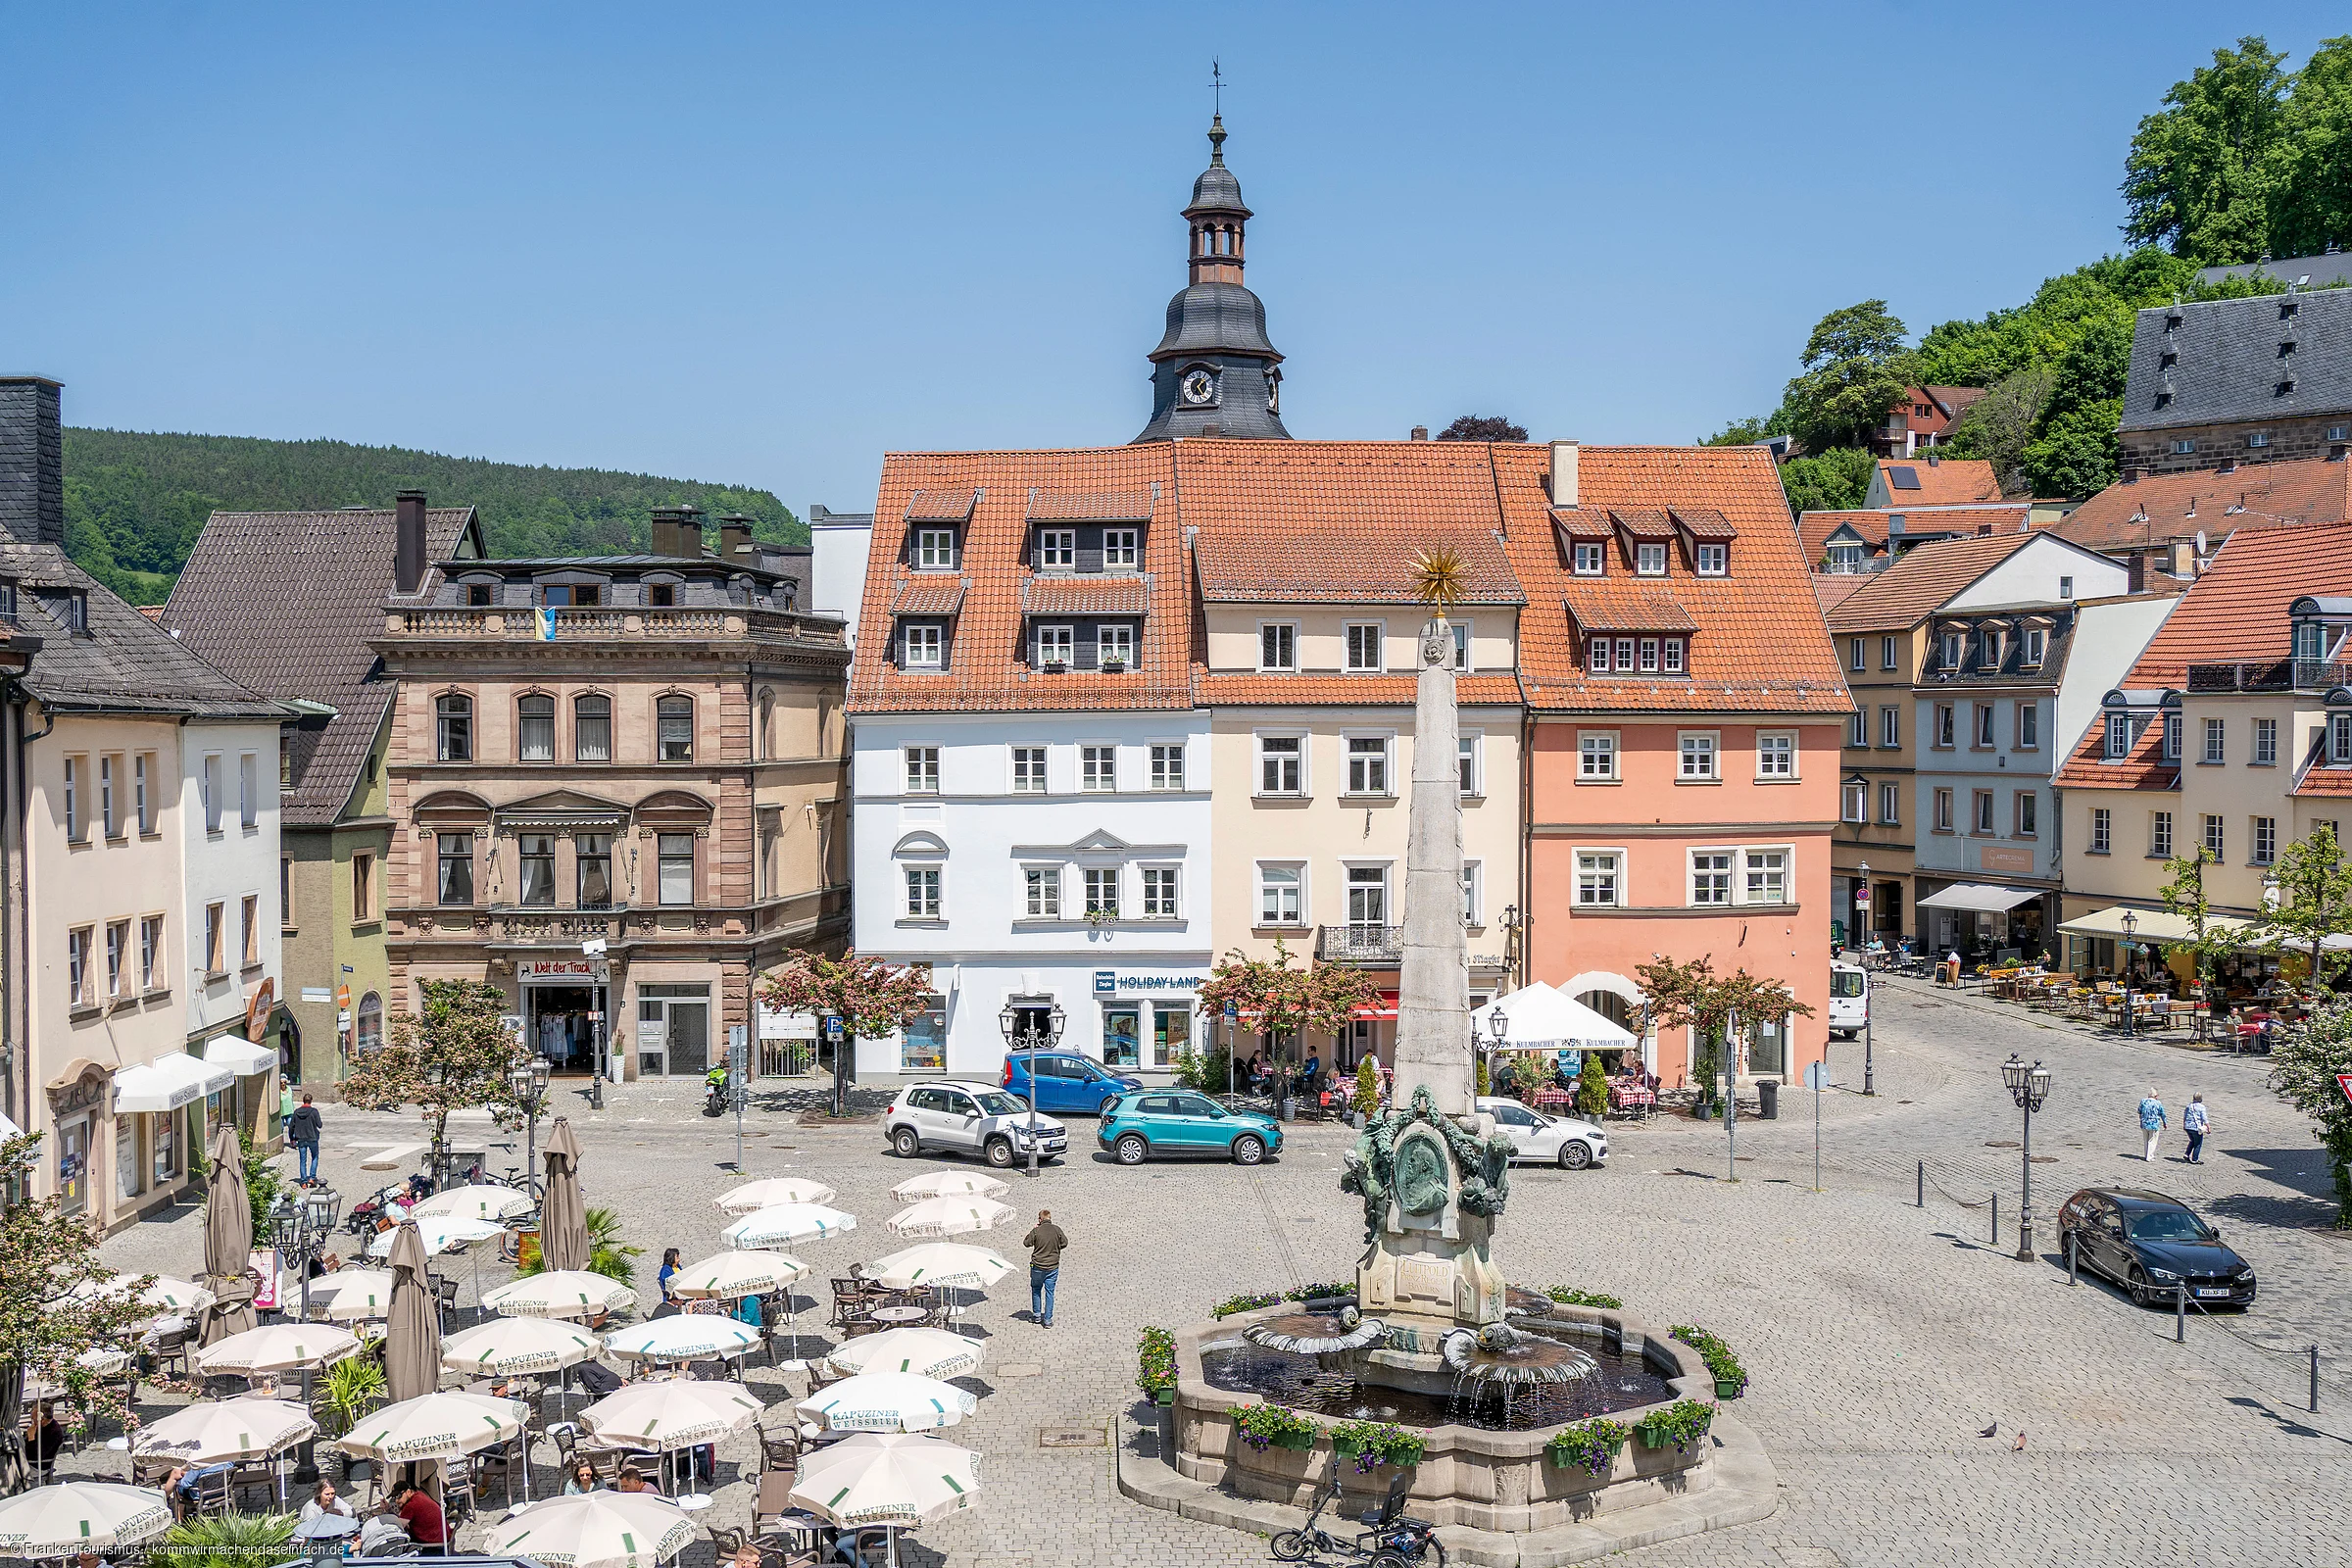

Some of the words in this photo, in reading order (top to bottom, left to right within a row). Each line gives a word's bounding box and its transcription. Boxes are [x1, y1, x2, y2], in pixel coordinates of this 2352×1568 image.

[535, 961, 551, 974] Welt
[553, 961, 565, 973] der
[1119, 977, 1167, 986] HOLIDAY
[1170, 976, 1200, 985] LAND
[1516, 1040, 1555, 1049] KULMBACHER
[258, 1055, 274, 1070] Feinkost
[743, 1230, 790, 1243] KAPUZINER
[1401, 1259, 1448, 1277] LUITPOLD
[721, 1274, 773, 1293] KAPUZINER
[722, 1280, 775, 1298] WEISSBIER
[287, 1300, 332, 1309] KAZINER
[499, 1299, 549, 1308] KAPUZINER
[497, 1350, 558, 1368] KAPUZINER
[657, 1344, 716, 1358] KAPUZINER
[497, 1357, 560, 1375] WEISSBIER
[922, 1352, 970, 1377] KAPUZINER
[932, 1358, 975, 1381] EISSBIER
[832, 1409, 899, 1421] KAPUZINER
[662, 1419, 726, 1443] KAPUZINER
[833, 1418, 899, 1430] WEISSBIER
[386, 1432, 457, 1454] KAPUZINER
[388, 1440, 459, 1461] WEISSBIER
[845, 1502, 917, 1519] KAPUZINER
[113, 1504, 166, 1538] KAPUZINER
[846, 1512, 916, 1527] WEISSBIER
[655, 1519, 692, 1553] KAPUZINER
